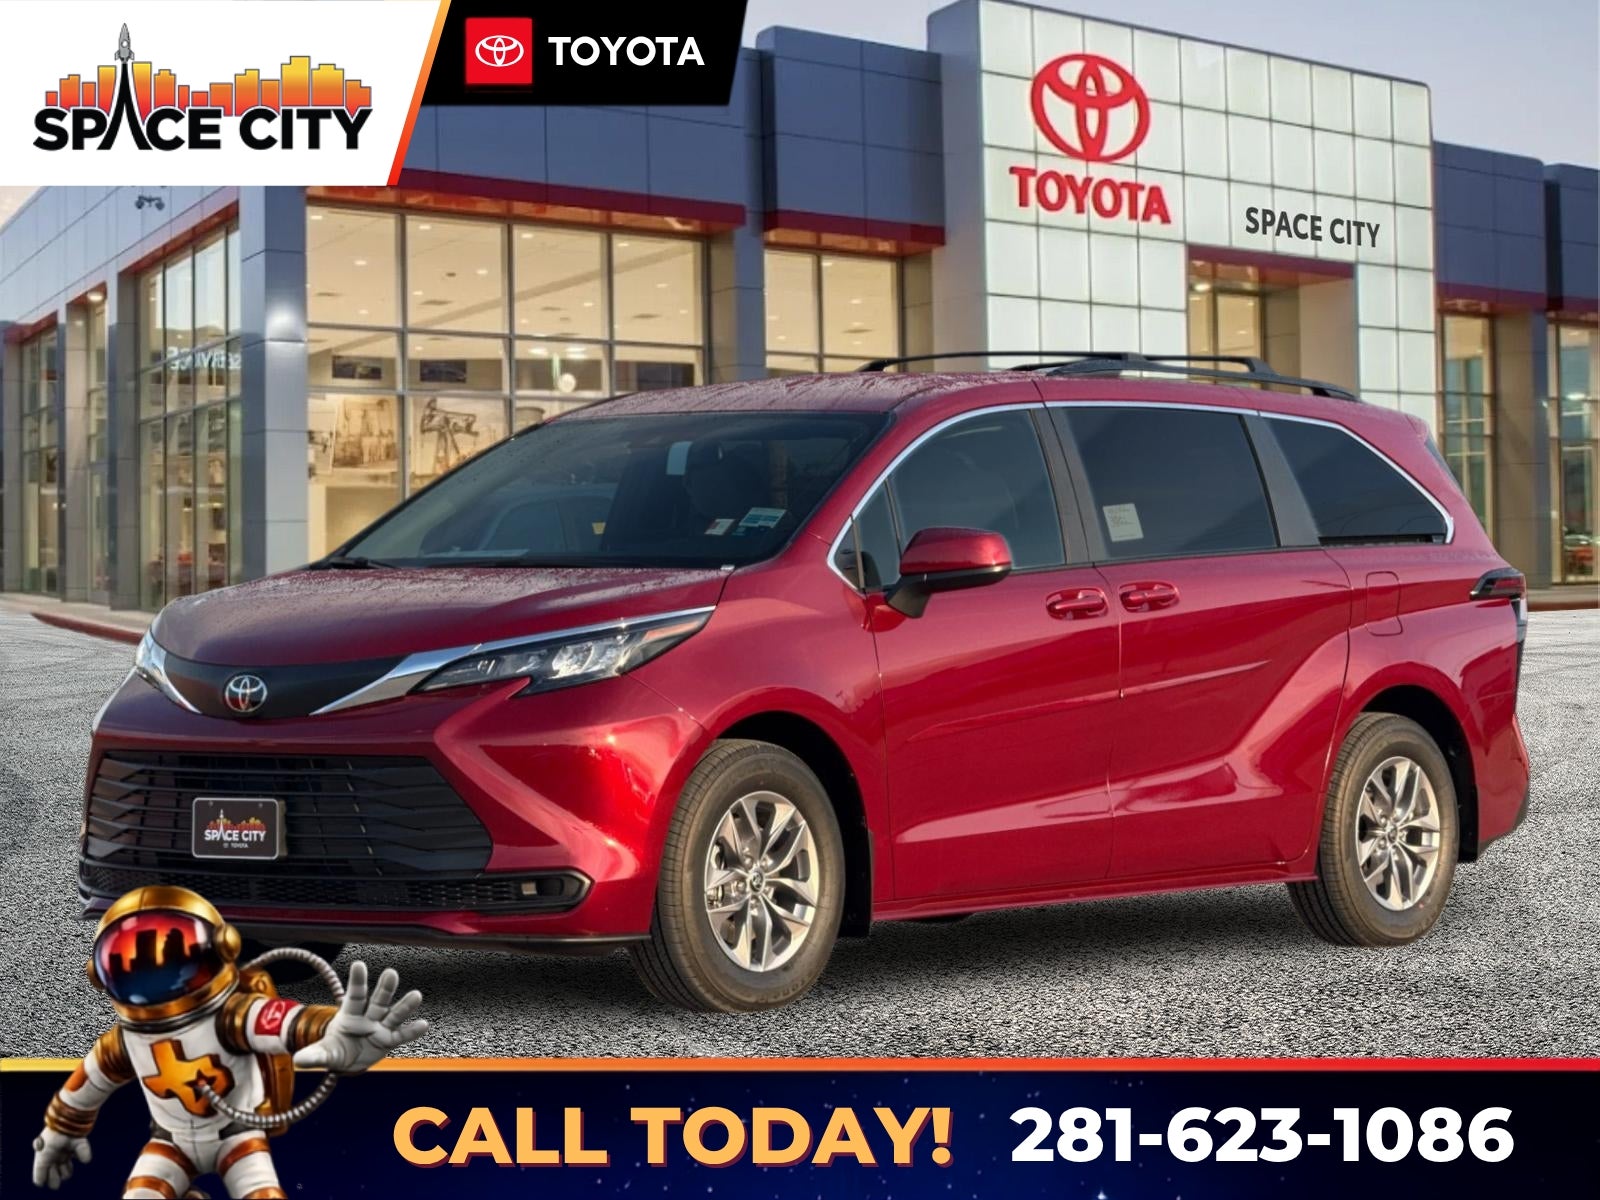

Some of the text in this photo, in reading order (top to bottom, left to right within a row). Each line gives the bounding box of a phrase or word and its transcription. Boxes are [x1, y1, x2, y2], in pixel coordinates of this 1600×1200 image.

[1009, 166, 1171, 224] TOYOTA
[1245, 206, 1381, 248] SPACE CITY
[204, 830, 266, 841] SPACE CITY
